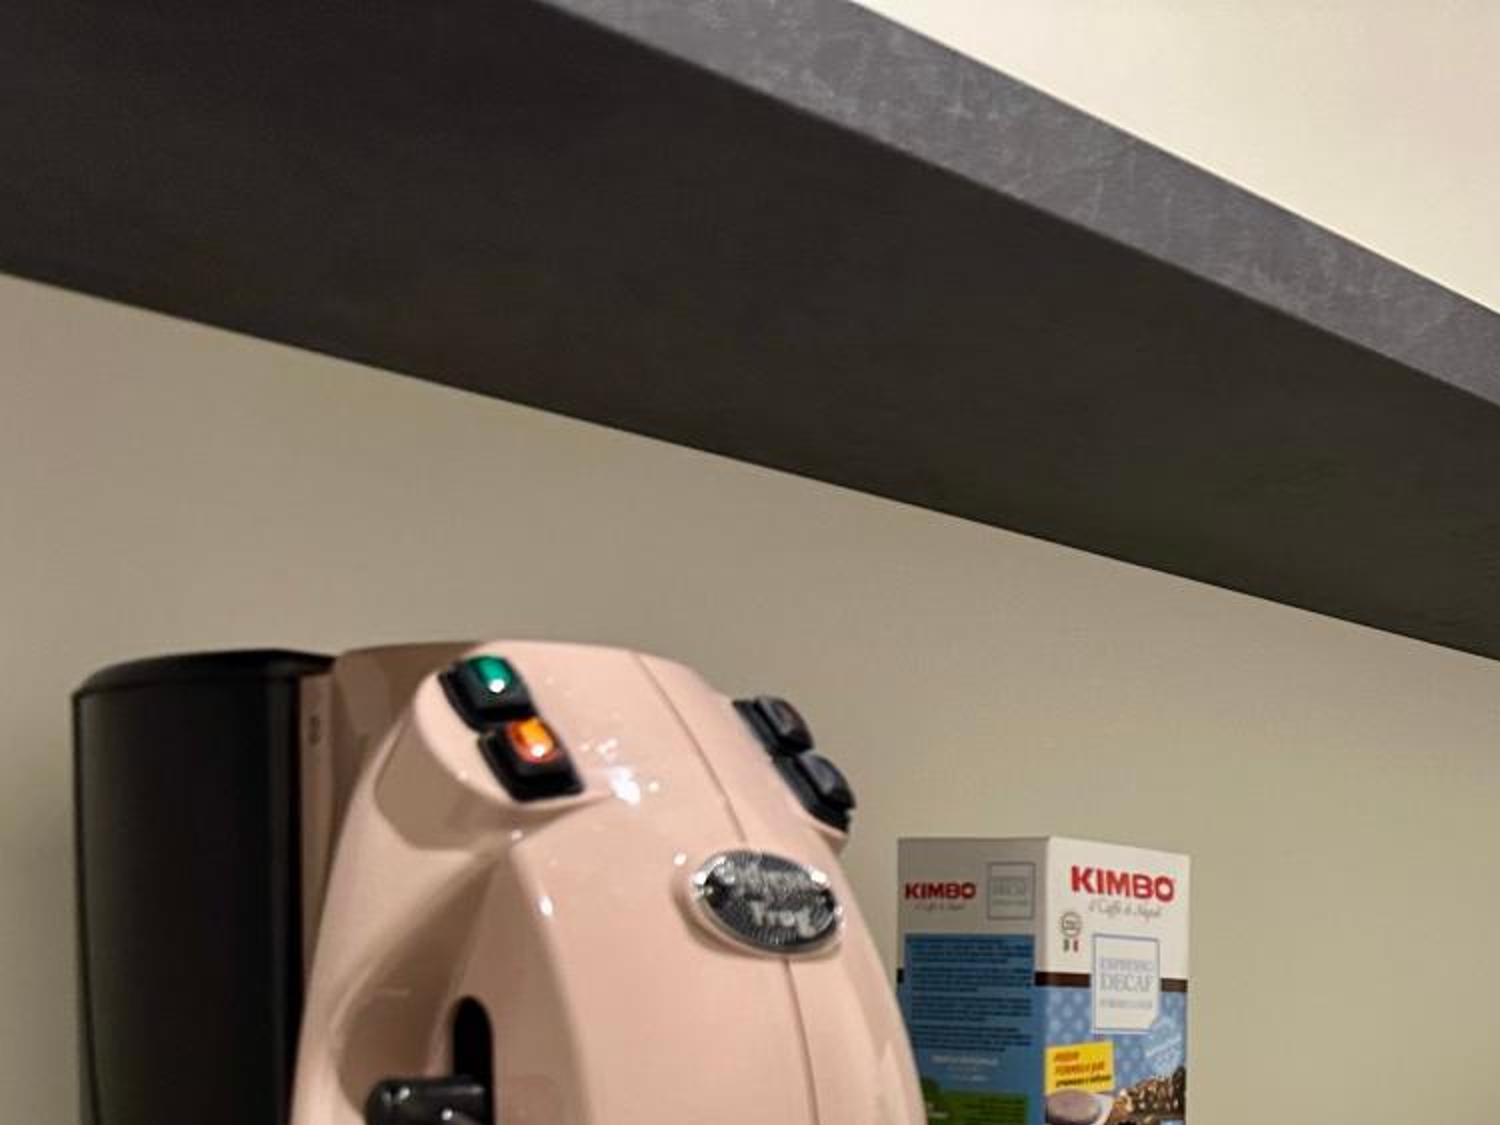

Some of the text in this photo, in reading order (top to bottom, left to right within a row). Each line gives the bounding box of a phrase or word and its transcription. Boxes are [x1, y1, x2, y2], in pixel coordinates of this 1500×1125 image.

[904, 881, 977, 900] KIMBO
[1071, 865, 1175, 903] KIMBO
[1100, 974, 1154, 993] DECAF
